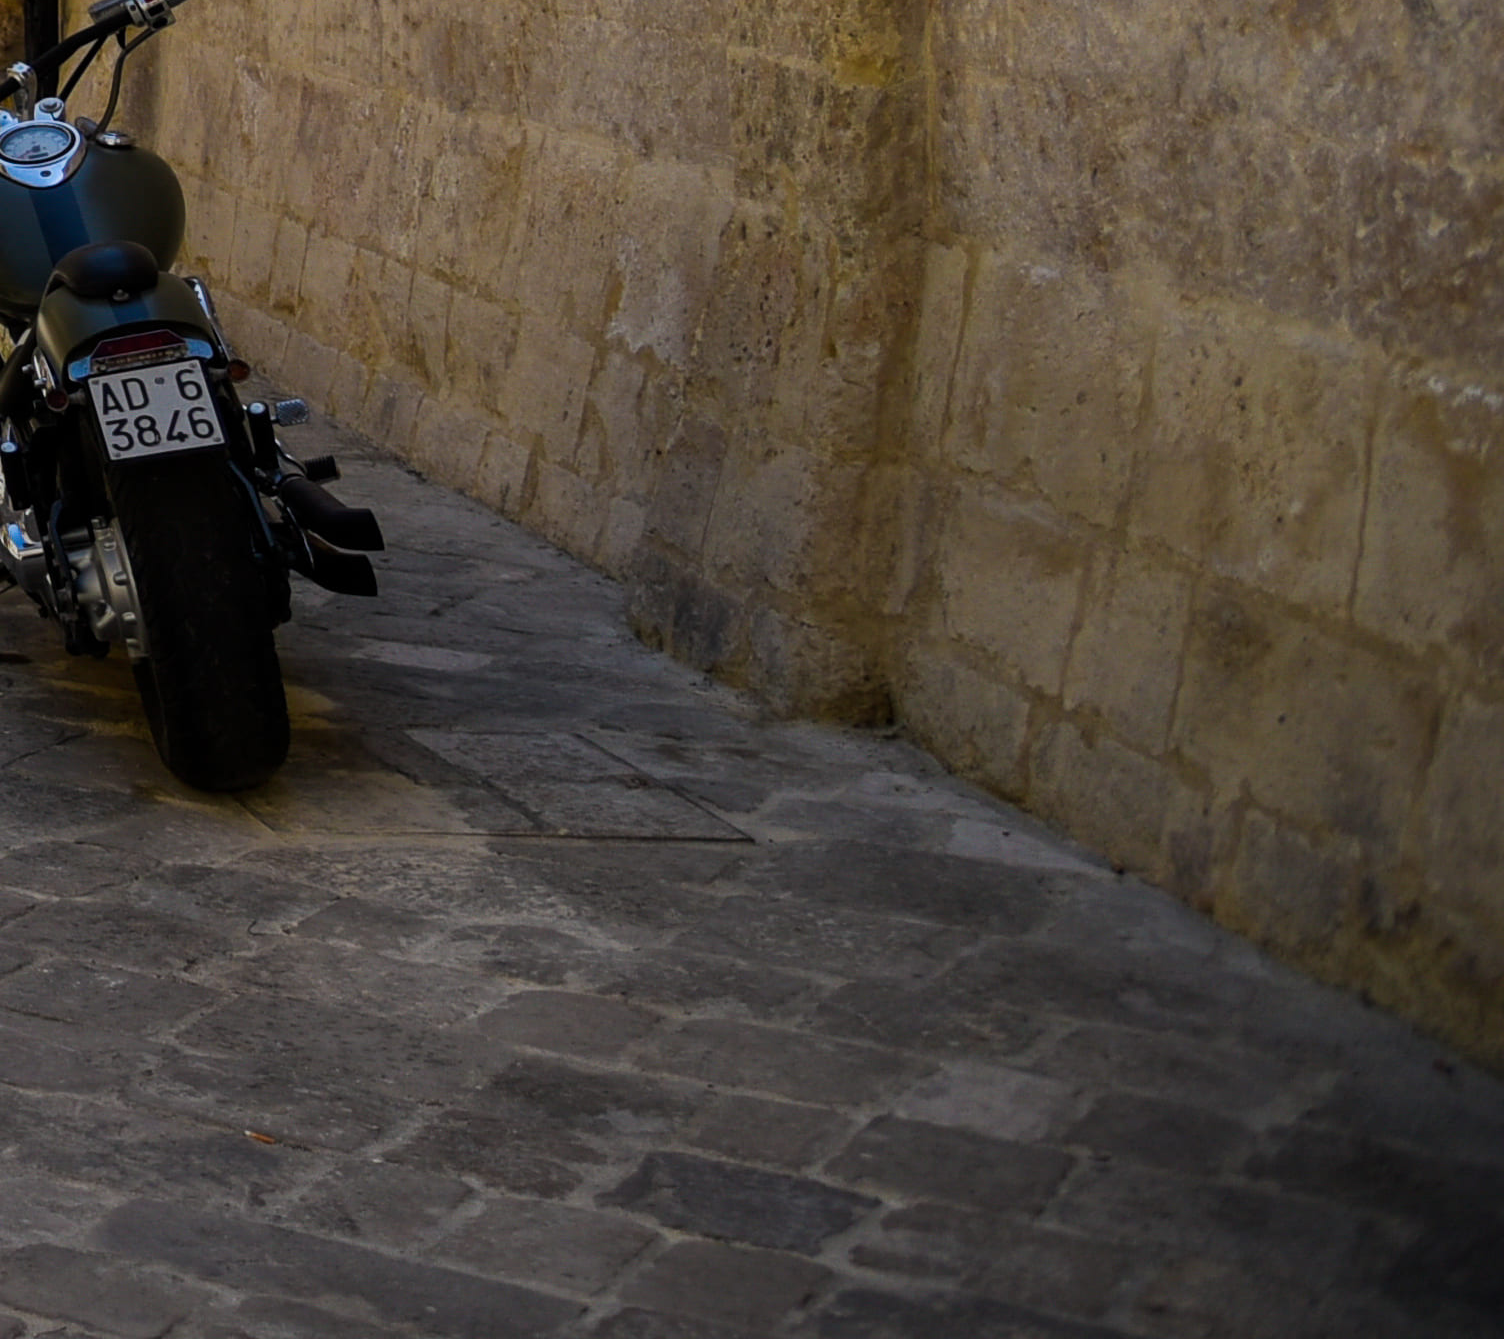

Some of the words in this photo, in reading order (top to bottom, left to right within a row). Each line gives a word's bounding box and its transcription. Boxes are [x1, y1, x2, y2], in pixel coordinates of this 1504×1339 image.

[102, 378, 149, 415] AD
[175, 369, 203, 401] 6
[105, 407, 215, 452] 3846
